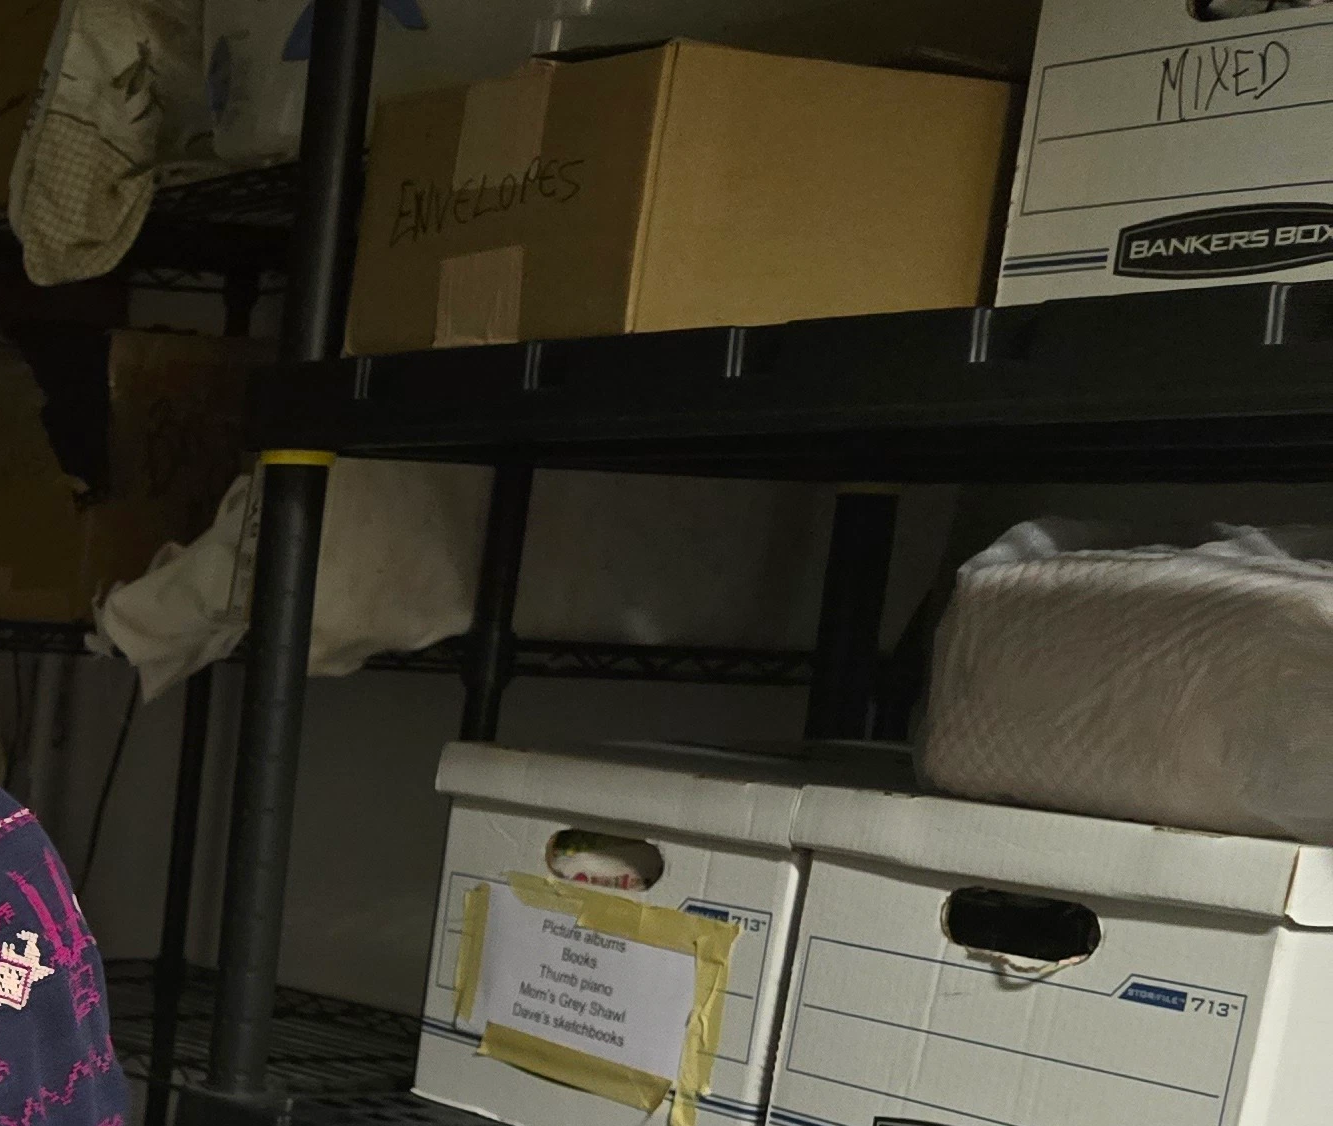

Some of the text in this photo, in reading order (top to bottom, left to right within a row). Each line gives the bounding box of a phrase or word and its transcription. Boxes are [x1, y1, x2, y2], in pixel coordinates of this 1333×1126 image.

[1156, 41, 1290, 122] MIXED
[389, 156, 584, 248] ENVELOPES
[1129, 229, 1270, 259] BANKERS
[541, 918, 627, 953] Picture albums
[561, 946, 598, 969] Books
[540, 963, 614, 997] Thumb piano
[519, 980, 627, 1024] Mom's Grey Shawl
[1191, 997, 1230, 1017] 713
[512, 1001, 625, 1048] Dave's sketchbooks
